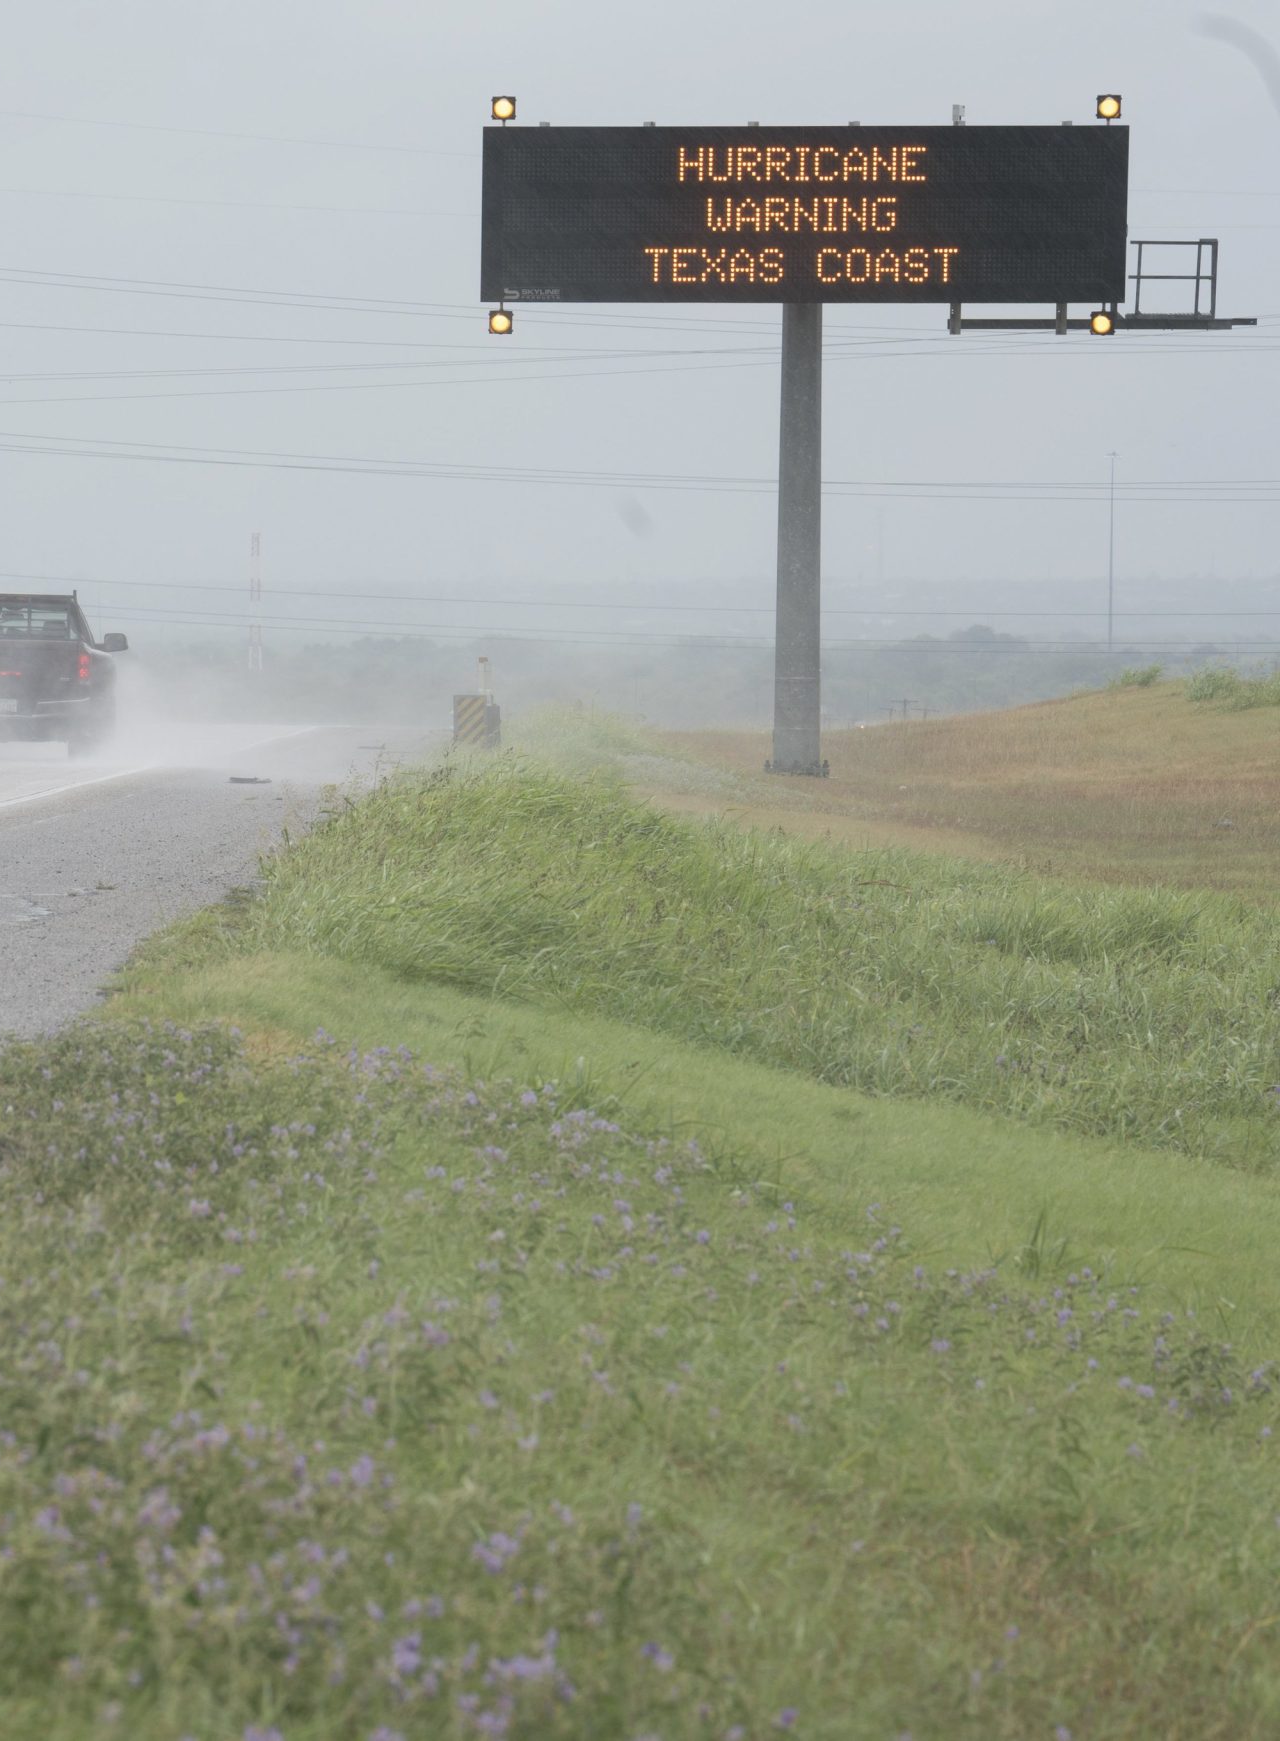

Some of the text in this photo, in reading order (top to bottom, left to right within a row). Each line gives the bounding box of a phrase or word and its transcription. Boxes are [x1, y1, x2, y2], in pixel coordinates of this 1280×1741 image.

[678, 145, 927, 182] HURRICANE
[706, 196, 897, 232] WARNING
[643, 246, 959, 283] TEXAS COAST
